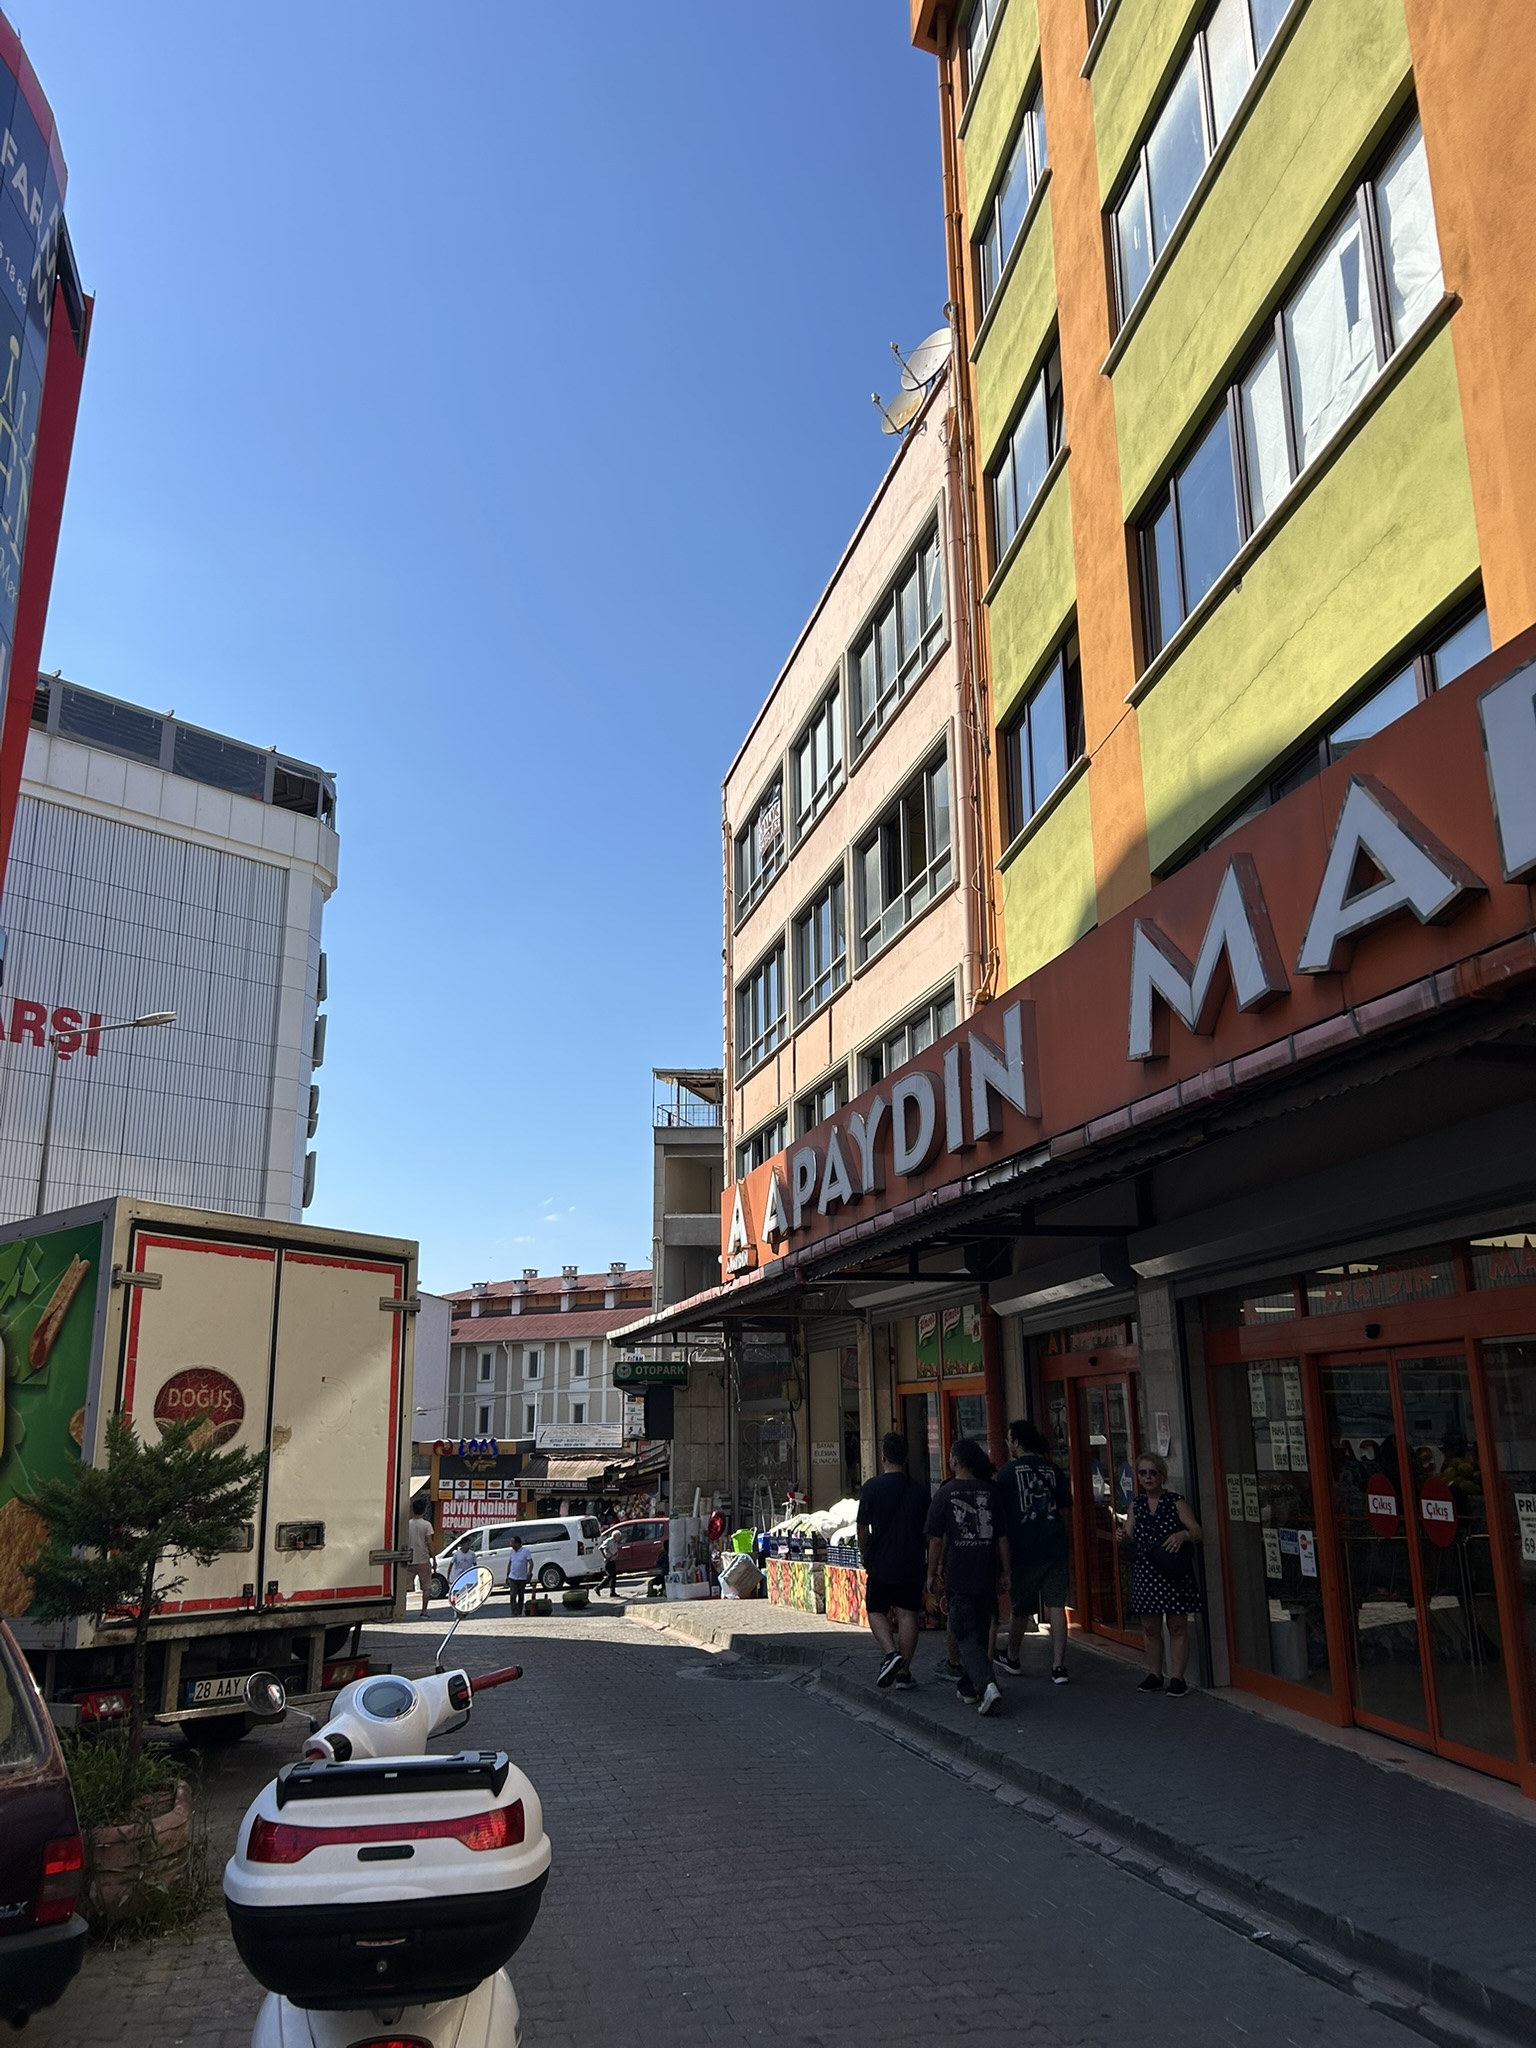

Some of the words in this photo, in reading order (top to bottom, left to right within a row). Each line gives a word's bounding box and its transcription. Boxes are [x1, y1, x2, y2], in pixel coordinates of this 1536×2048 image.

[727, 1178, 752, 1256] A
[762, 1001, 1032, 1245] APAYDIN
[1128, 655, 1536, 1062] MA
[0, 998, 102, 1060] RŞI
[635, 1365, 684, 1375] OTOPARK
[168, 1383, 232, 1412] DOĞUŞ
[442, 1500, 476, 1515] BÜYÜK
[477, 1500, 517, 1515] İNDİRİM
[1372, 1497, 1392, 1511] Çıkış
[1426, 1502, 1449, 1519] Çıkış
[441, 1517, 471, 1528] DEPOLARI
[195, 1682, 211, 1699] 28
[216, 1678, 241, 1697] AAY
